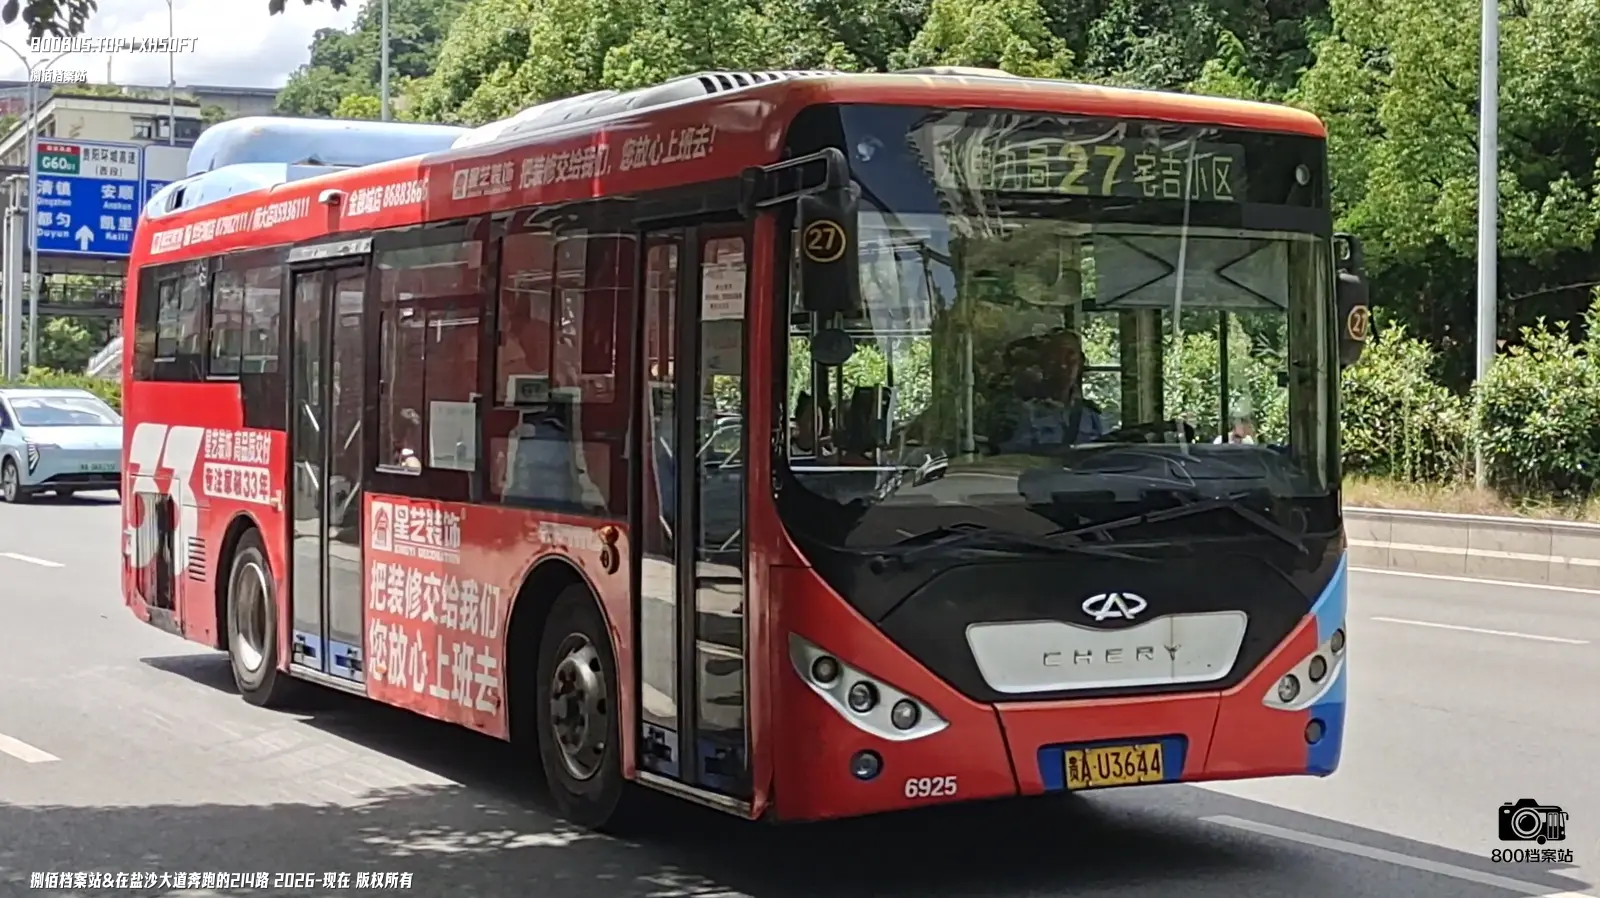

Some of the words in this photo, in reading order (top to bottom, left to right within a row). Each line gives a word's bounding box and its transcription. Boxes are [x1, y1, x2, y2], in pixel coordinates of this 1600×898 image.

[1060, 143, 1126, 196] 27
[1132, 152, 1235, 200] 宅吉小区
[100, 184, 135, 201] 安顺
[37, 211, 71, 228] 都匀
[105, 231, 129, 241] Kaili
[808, 228, 836, 250] 27
[394, 503, 461, 549] 星艺装饰
[369, 560, 500, 639] 把装修交给我们
[368, 618, 500, 716] 您放心上班去
[1043, 643, 1183, 668] CHERY
[904, 775, 958, 798] 6925
